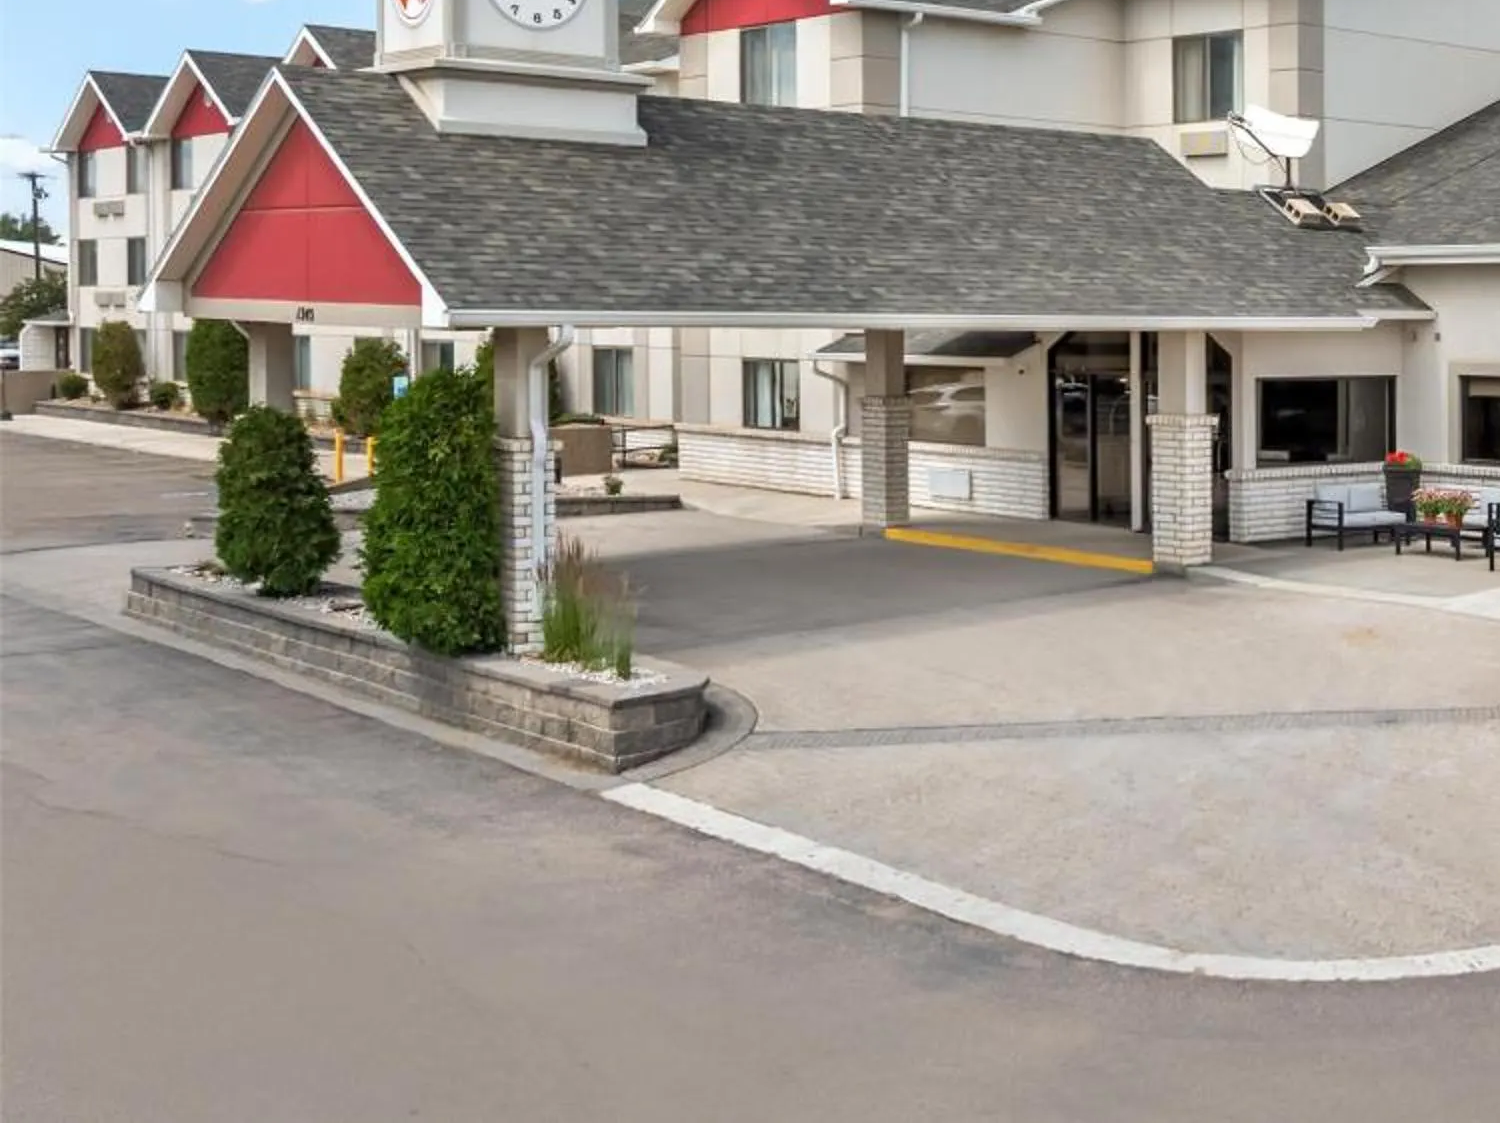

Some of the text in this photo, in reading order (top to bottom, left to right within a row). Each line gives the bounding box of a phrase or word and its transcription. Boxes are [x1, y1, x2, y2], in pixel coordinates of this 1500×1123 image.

[510, 4, 520, 16] 7
[553, 8, 562, 20] 5
[533, 12, 542, 24] 6
